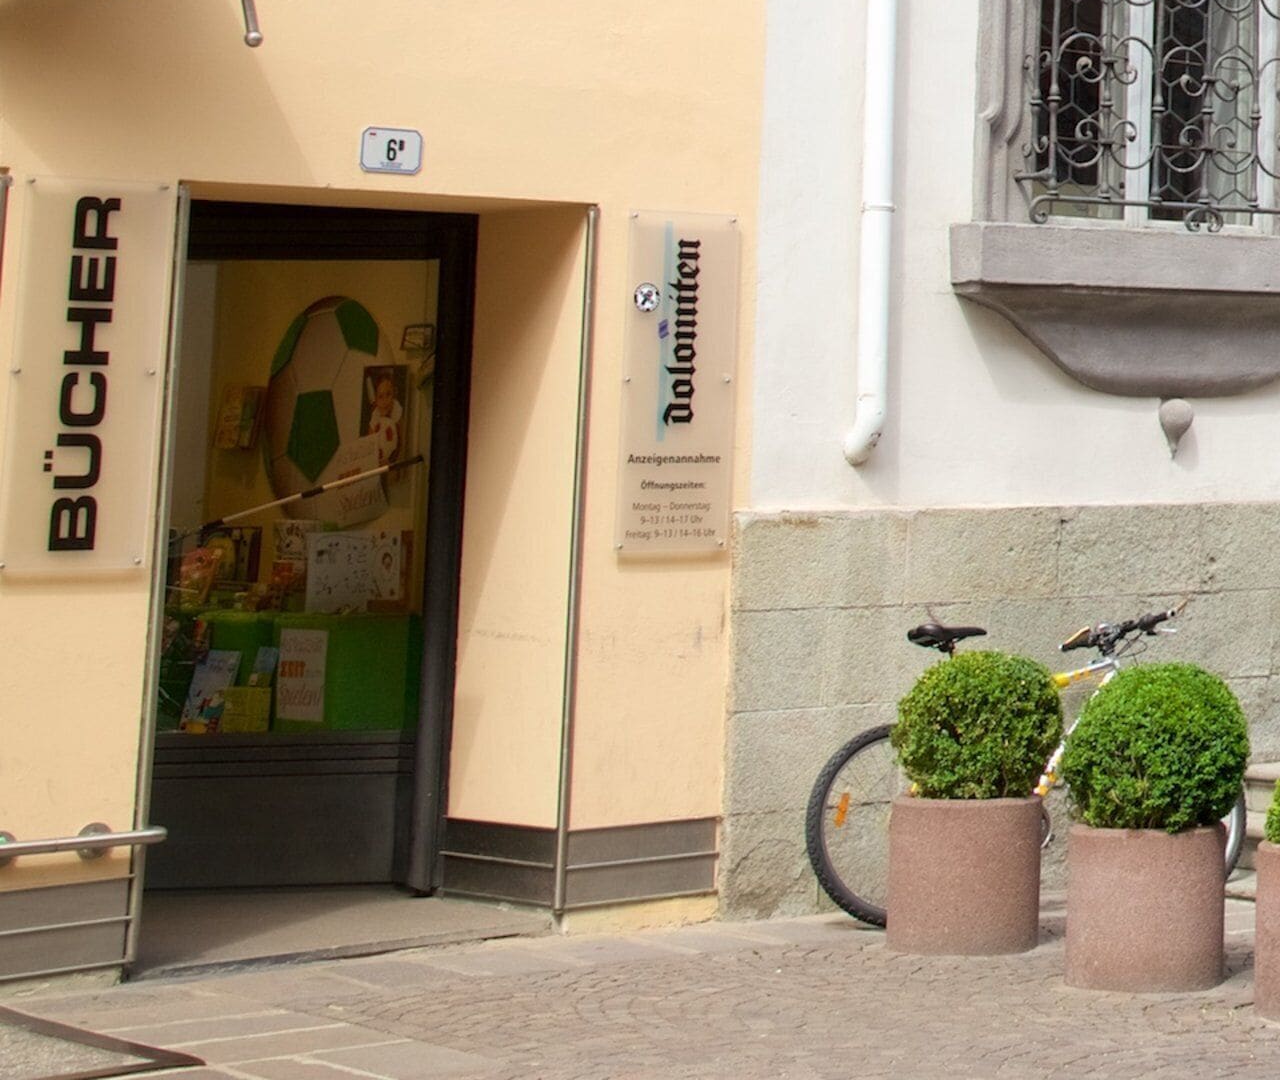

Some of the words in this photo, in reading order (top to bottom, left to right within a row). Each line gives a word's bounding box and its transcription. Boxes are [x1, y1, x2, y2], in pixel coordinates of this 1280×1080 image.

[663, 238, 701, 426] Dolomiten
[43, 196, 122, 552] BÜCHER
[627, 453, 721, 467] Anzeigenannahme
[632, 502, 661, 513] Montag
[690, 514, 704, 524] Uhr
[703, 527, 716, 537] Uhr
